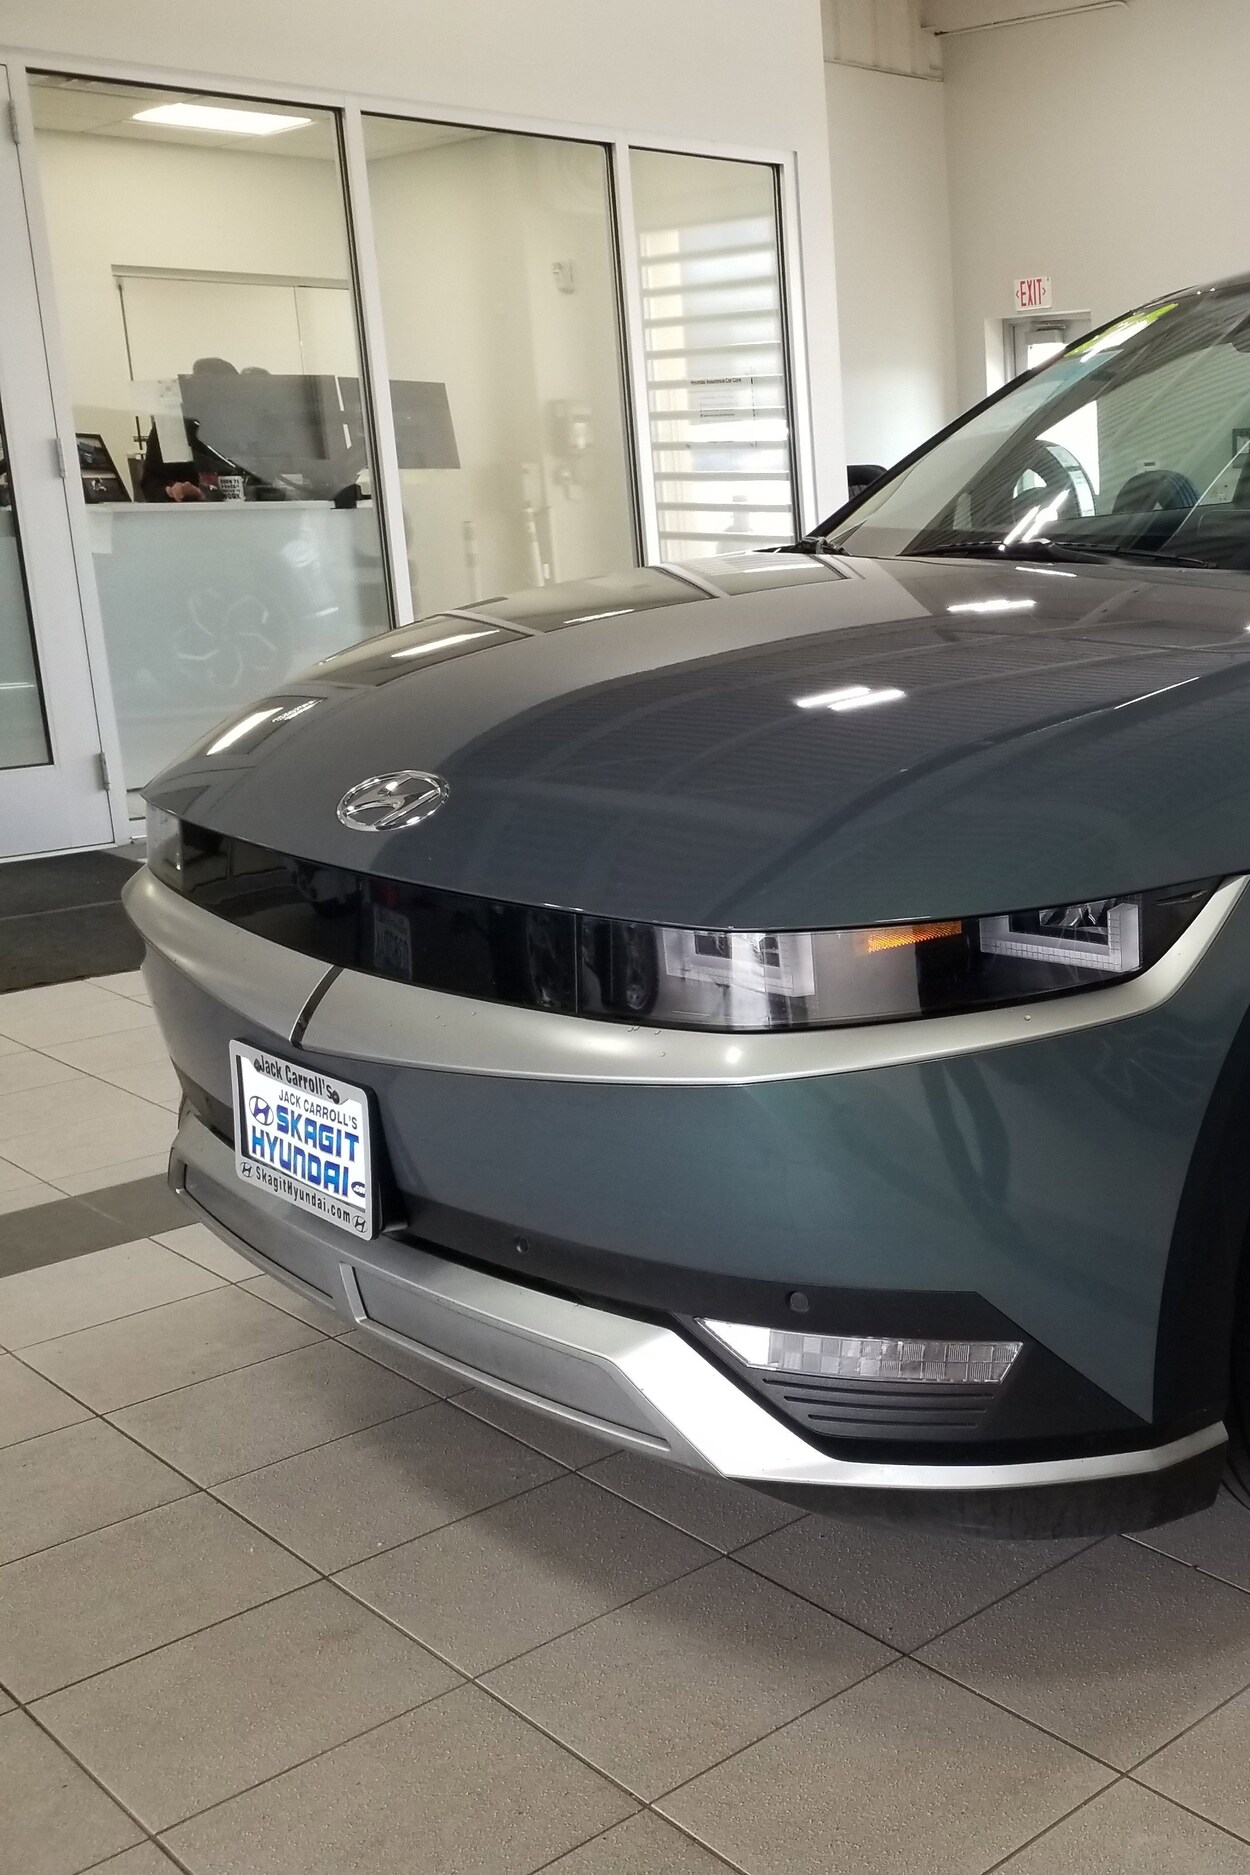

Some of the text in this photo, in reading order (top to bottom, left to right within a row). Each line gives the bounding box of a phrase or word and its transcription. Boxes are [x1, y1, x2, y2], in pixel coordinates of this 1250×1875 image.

[1019, 278, 1042, 307] EXIT
[258, 1054, 332, 1100] Jack Carroll's
[276, 1105, 360, 1162] SKAGIT
[278, 1088, 358, 1131] JACK CARROLL'S
[251, 1125, 350, 1198] HYUNDAI
[255, 1166, 351, 1224] SkagitHyundai.com
